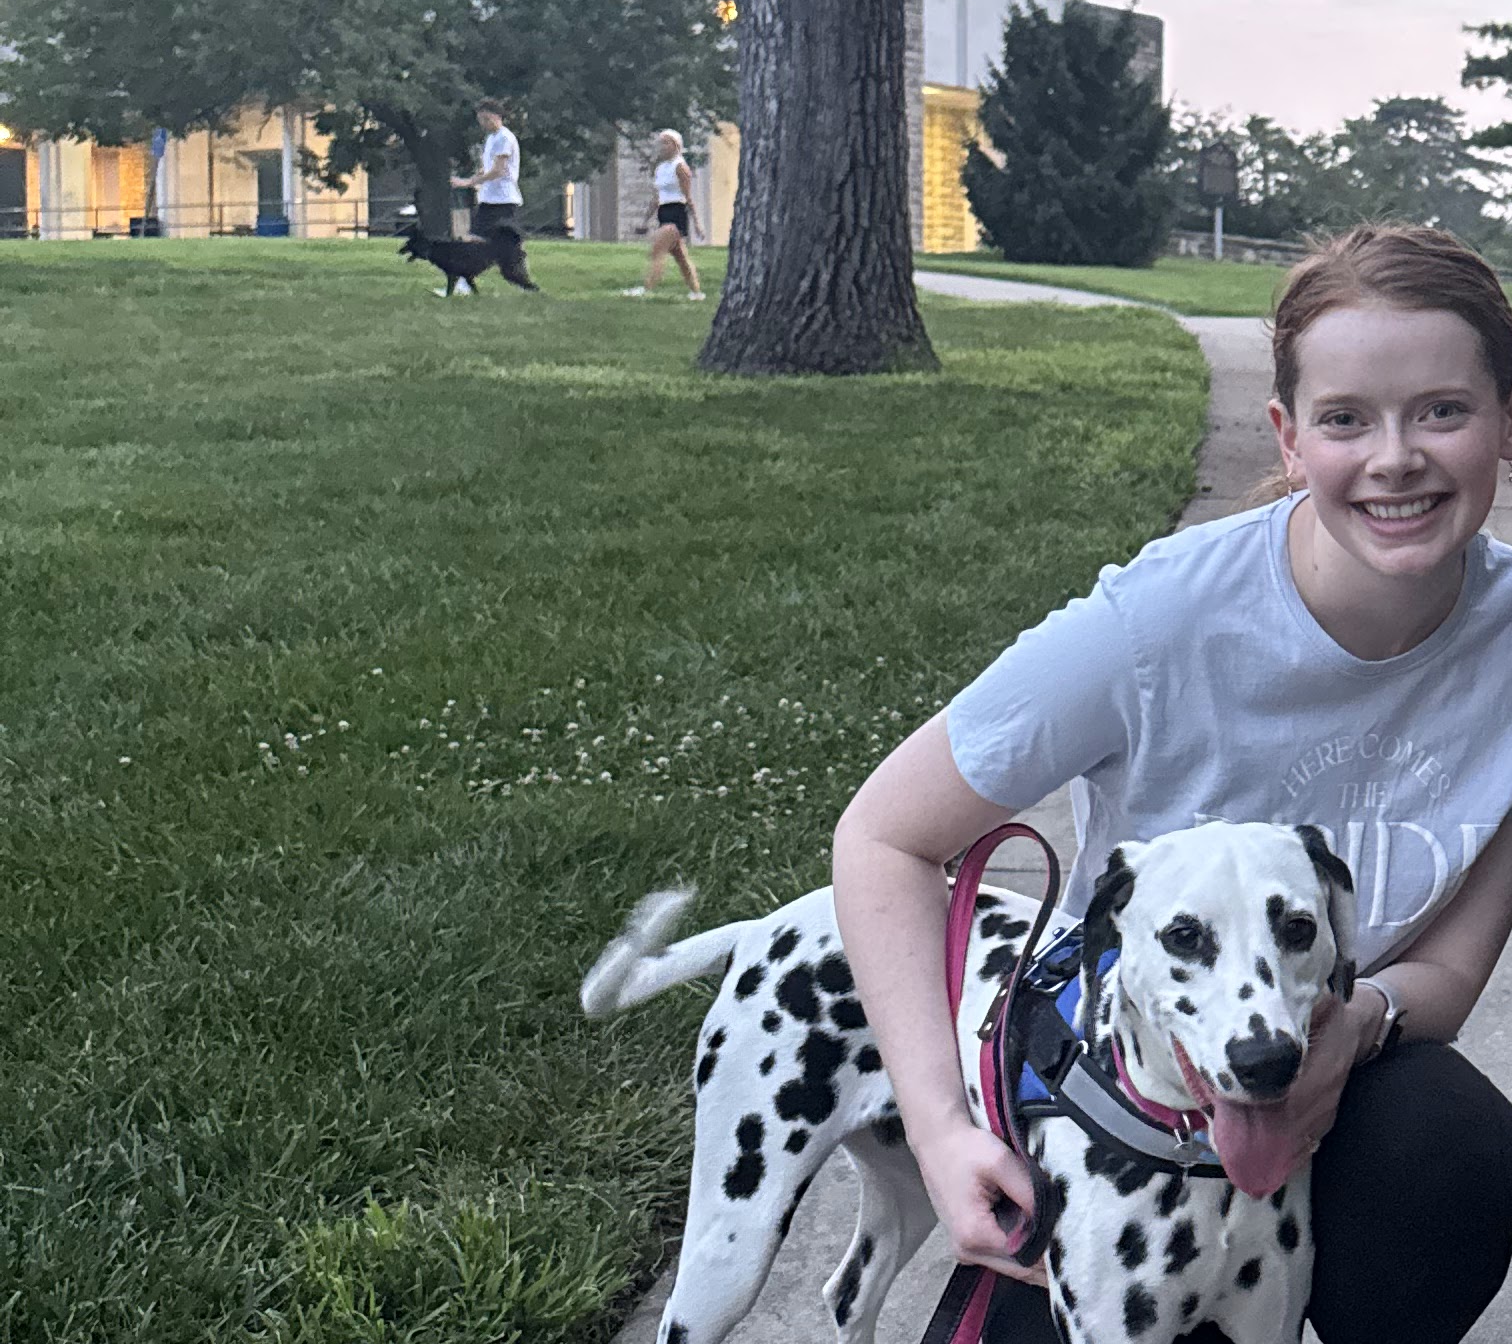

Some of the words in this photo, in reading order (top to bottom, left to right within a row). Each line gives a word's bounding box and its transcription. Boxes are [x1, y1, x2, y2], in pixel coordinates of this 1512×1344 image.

[1282, 736, 1353, 798] HERE
[1358, 733, 1451, 799] COMES
[1338, 781, 1388, 809] THE
